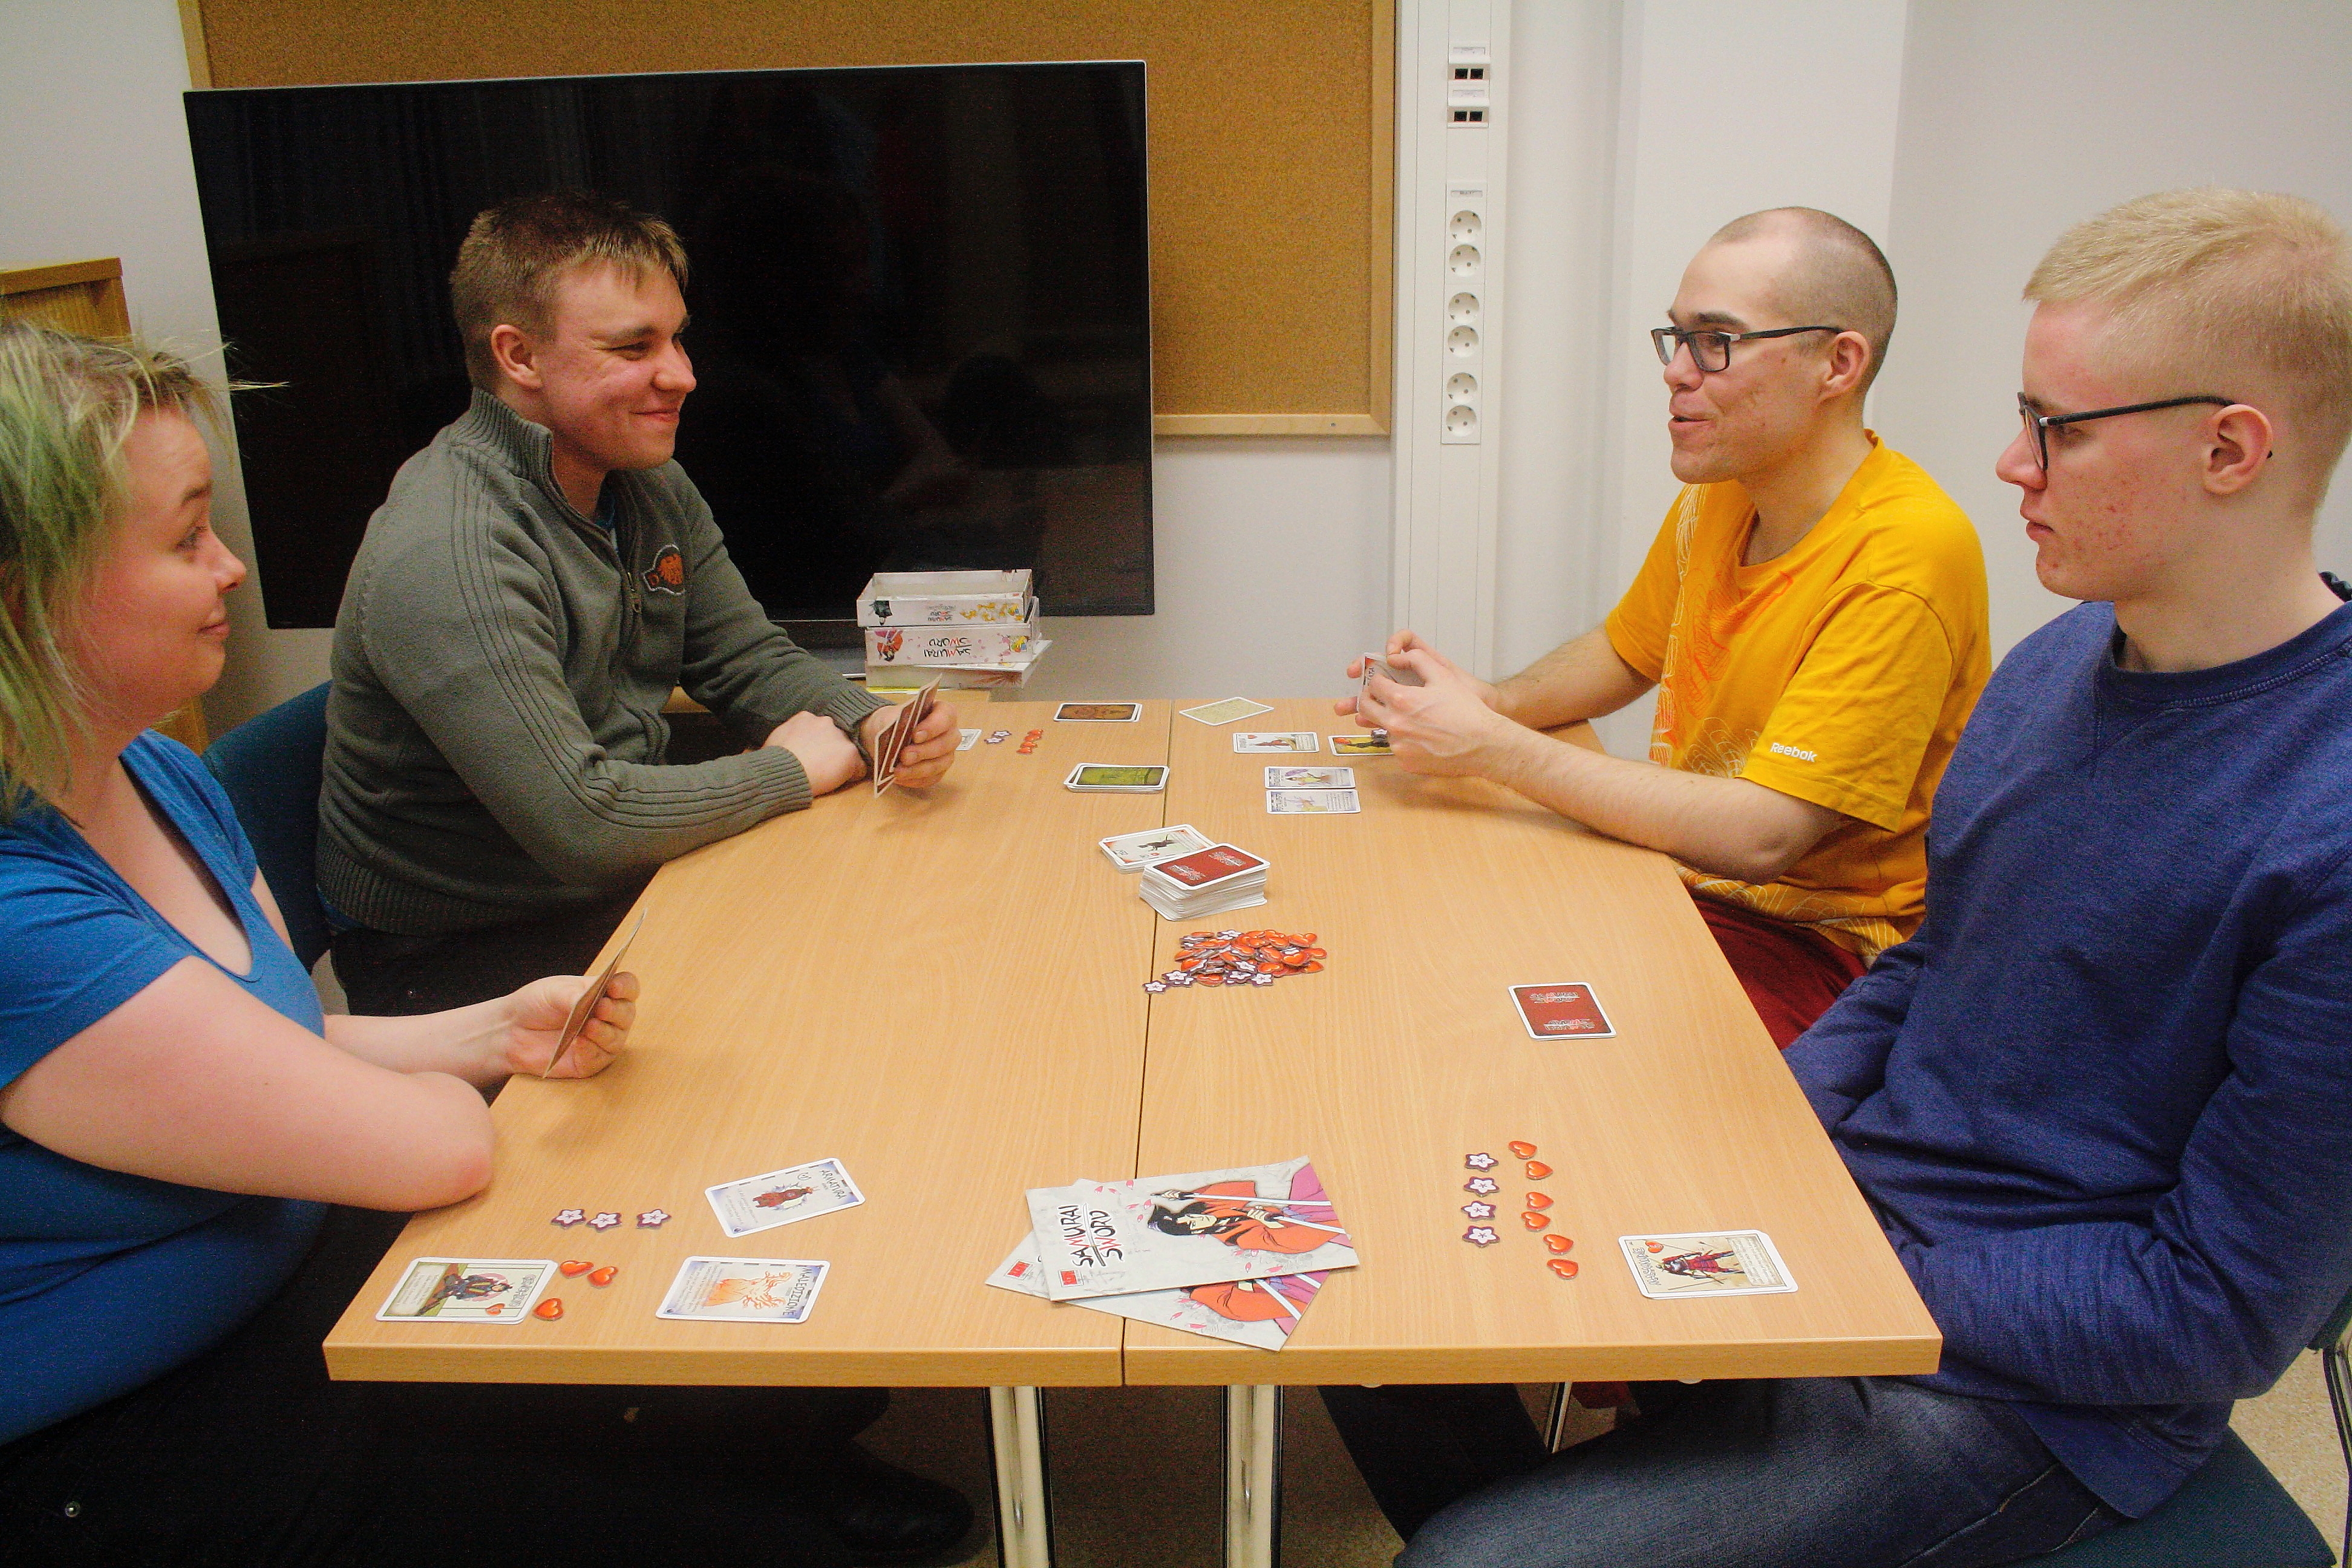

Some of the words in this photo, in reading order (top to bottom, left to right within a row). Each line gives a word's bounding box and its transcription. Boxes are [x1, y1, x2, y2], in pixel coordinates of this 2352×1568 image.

[924, 648, 972, 658] SAMURAI
[929, 638, 968, 647] SWORD
[1770, 742, 1818, 762] Reebok
[820, 1170, 847, 1200] ARMATURA
[1058, 1205, 1094, 1267] SAMURAI
[1089, 1210, 1123, 1261] SWORD
[783, 1267, 812, 1315] MALEDIZIONE
